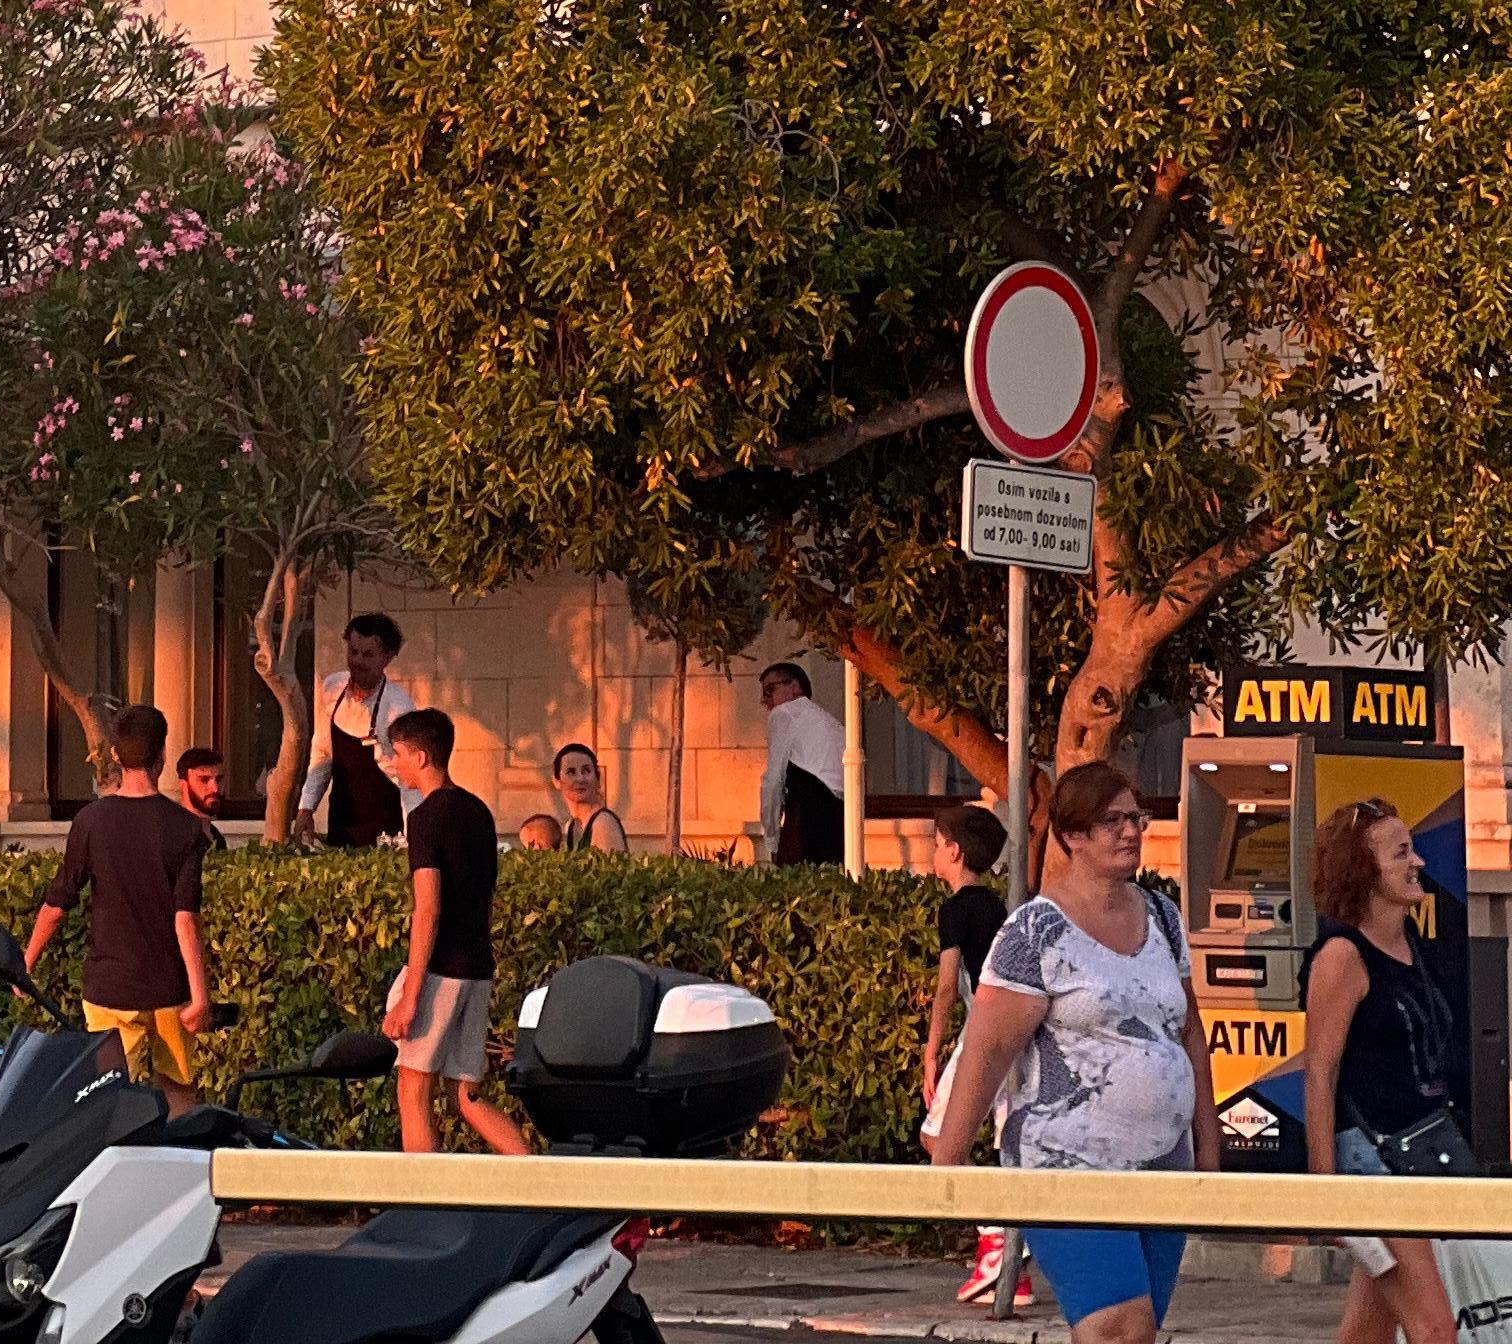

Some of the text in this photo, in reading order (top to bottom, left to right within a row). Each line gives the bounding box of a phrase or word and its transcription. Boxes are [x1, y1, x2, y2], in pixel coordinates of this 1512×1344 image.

[998, 479, 1070, 504] Osim vozila s
[977, 503, 1087, 530] posebnom dozvolom
[983, 526, 996, 541] od
[1060, 538, 1081, 553] sati
[1234, 680, 1331, 723] ATM
[1352, 681, 1427, 727] ATM
[1208, 1020, 1287, 1056] ATM
